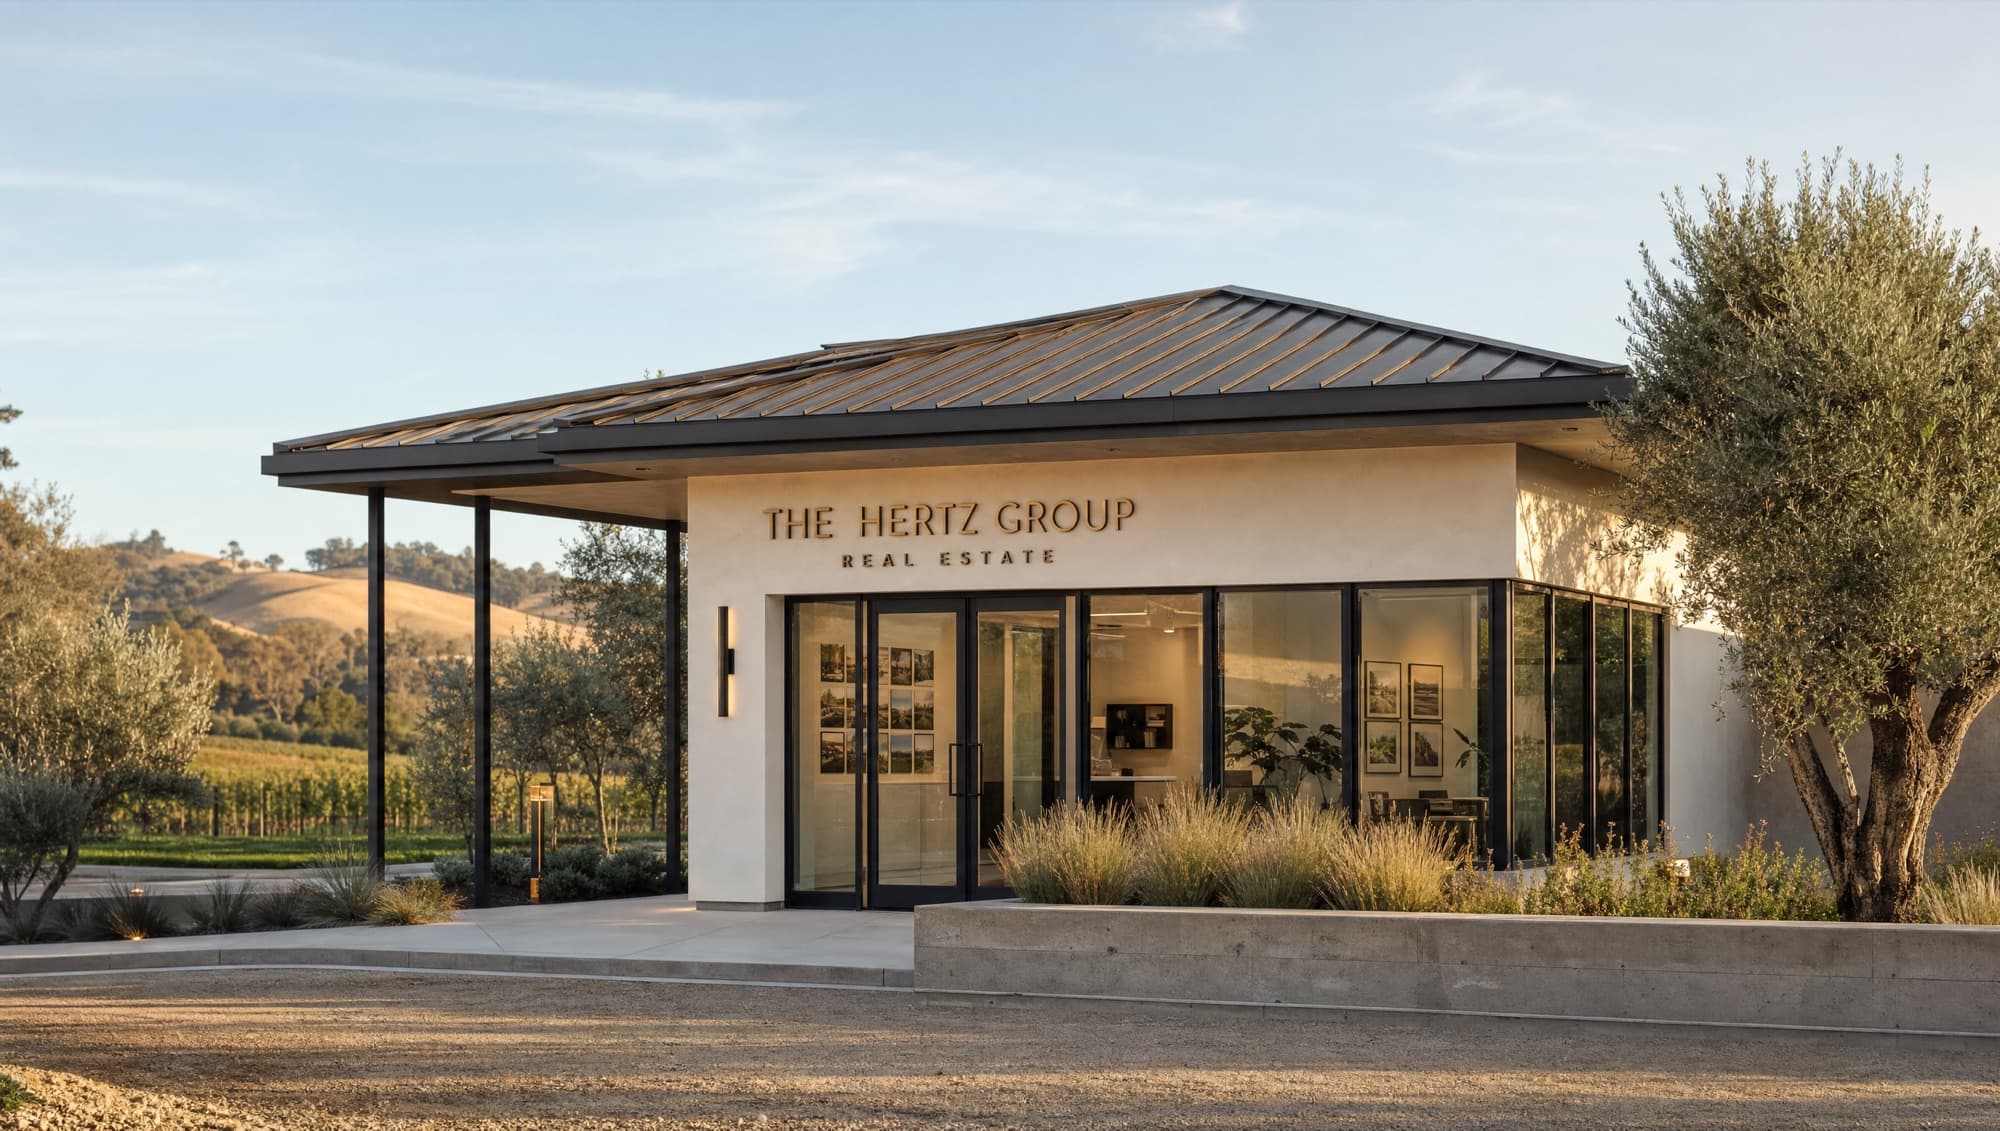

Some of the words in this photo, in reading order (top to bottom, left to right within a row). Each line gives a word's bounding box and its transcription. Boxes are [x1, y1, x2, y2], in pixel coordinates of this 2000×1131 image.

[762, 507, 834, 540] THE
[858, 503, 978, 537] HERTZ
[995, 497, 1135, 533] GROUP
[842, 553, 915, 568] REAL
[940, 549, 1056, 566] ESTATE
